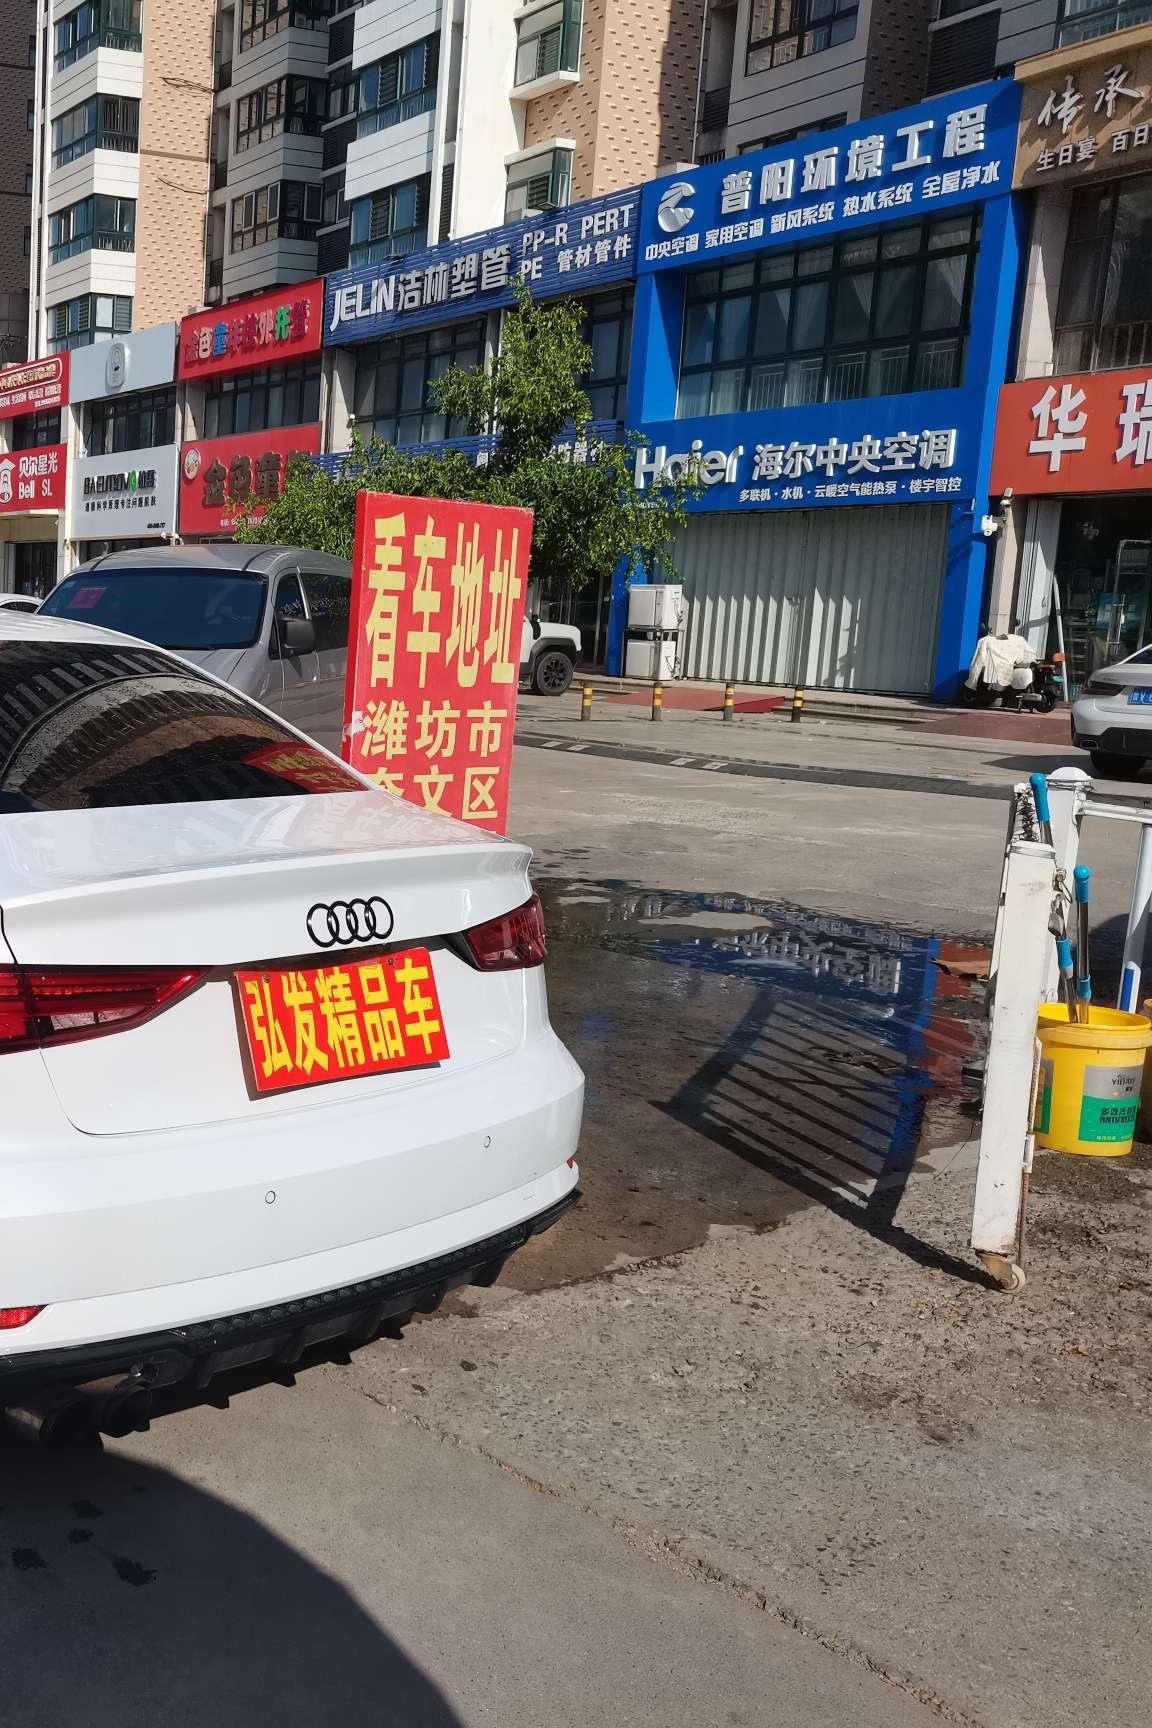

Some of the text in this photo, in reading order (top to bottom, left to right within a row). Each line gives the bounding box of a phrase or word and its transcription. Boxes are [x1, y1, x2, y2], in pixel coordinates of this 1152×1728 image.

[721, 103, 988, 216] 普阳环境工程
[1036, 136, 1096, 172] 生日宴
[522, 204, 634, 257] PP-R PERT
[645, 161, 1001, 261] 中央空调 家用空调 新风系统 热水系统 全屋净水
[520, 235, 632, 281] PE 管材管件
[329, 275, 396, 333] JELIN
[19, 452, 57, 478] 贝尔星光
[205, 449, 311, 505] 金色童
[634, 429, 957, 489] Haier 海尔中央空调
[19, 479, 52, 499] Bell SL
[366, 512, 522, 689] 看车地址
[360, 699, 508, 760] 潍坊市
[245, 957, 441, 1079] 弘发精品车
